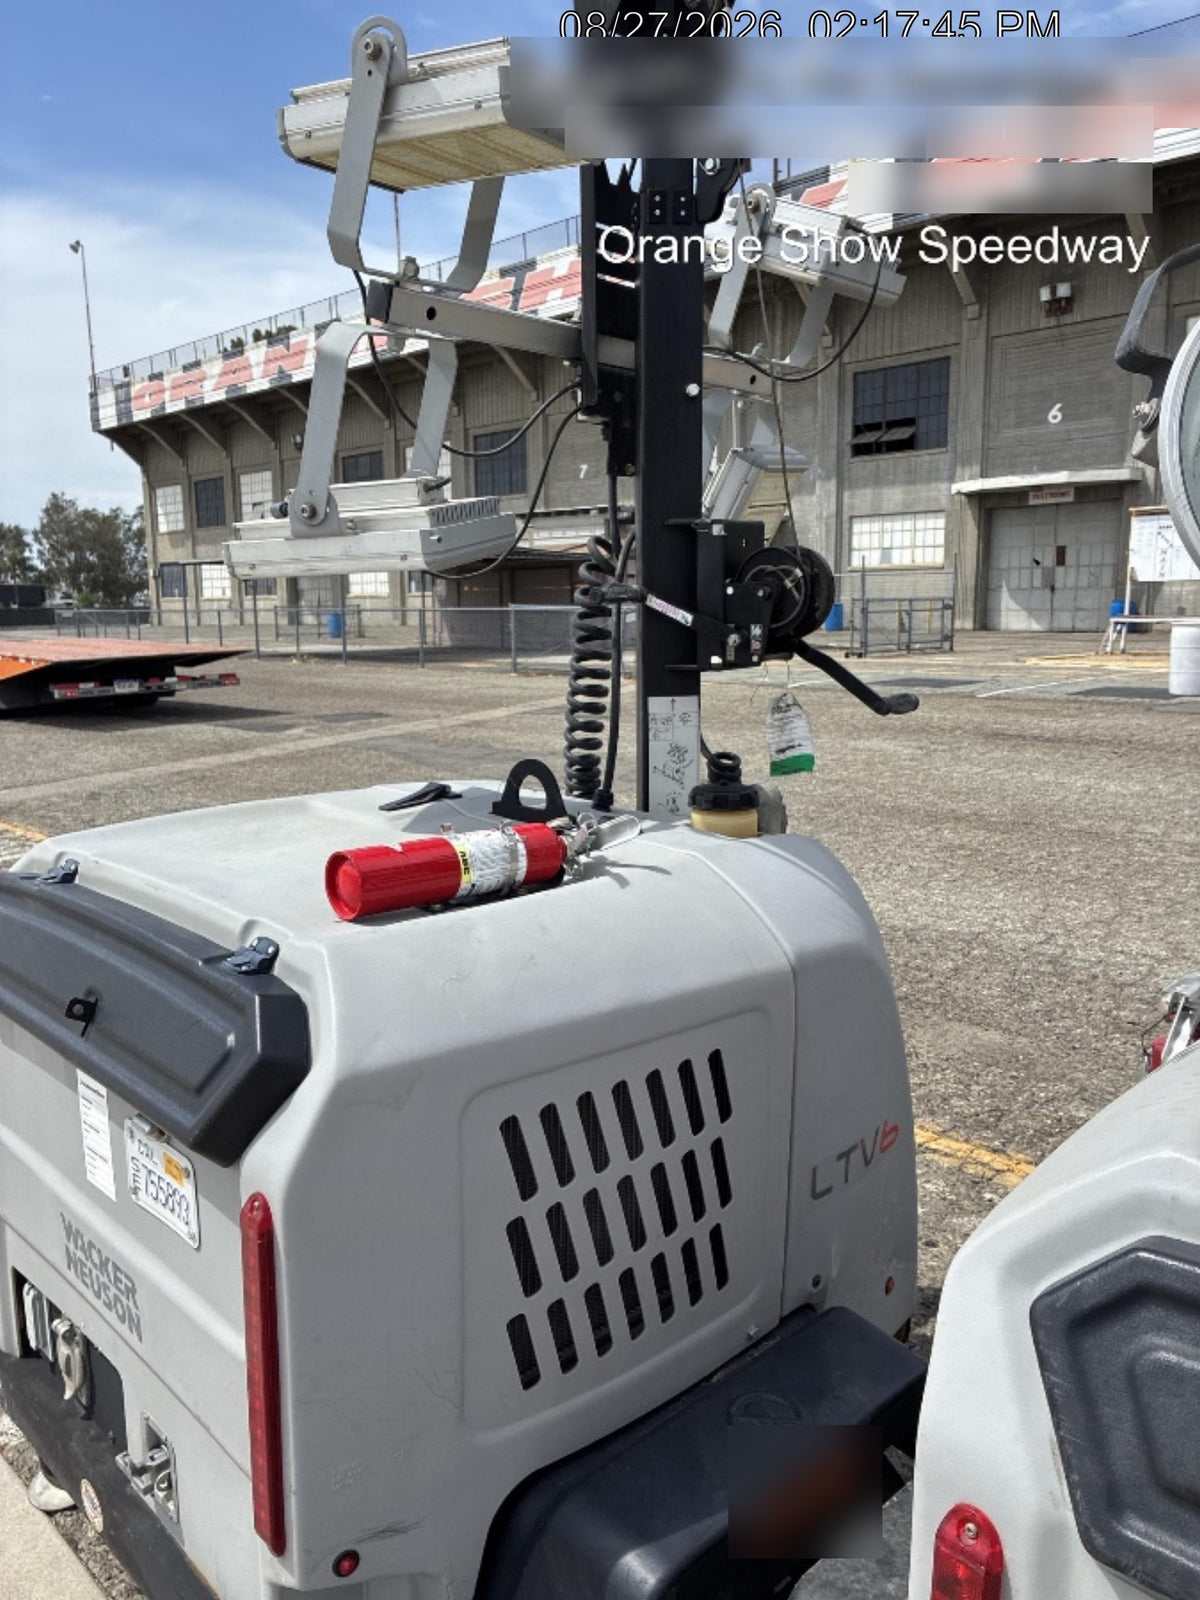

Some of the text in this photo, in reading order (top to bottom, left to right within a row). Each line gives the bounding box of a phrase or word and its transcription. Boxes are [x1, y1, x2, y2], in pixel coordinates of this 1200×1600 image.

[1047, 402, 1063, 424] 6
[579, 463, 588, 479] 7
[811, 1119, 899, 1200] LTV6
[60, 1211, 140, 1311] WACKER
[65, 1243, 143, 1343] NEUSON
